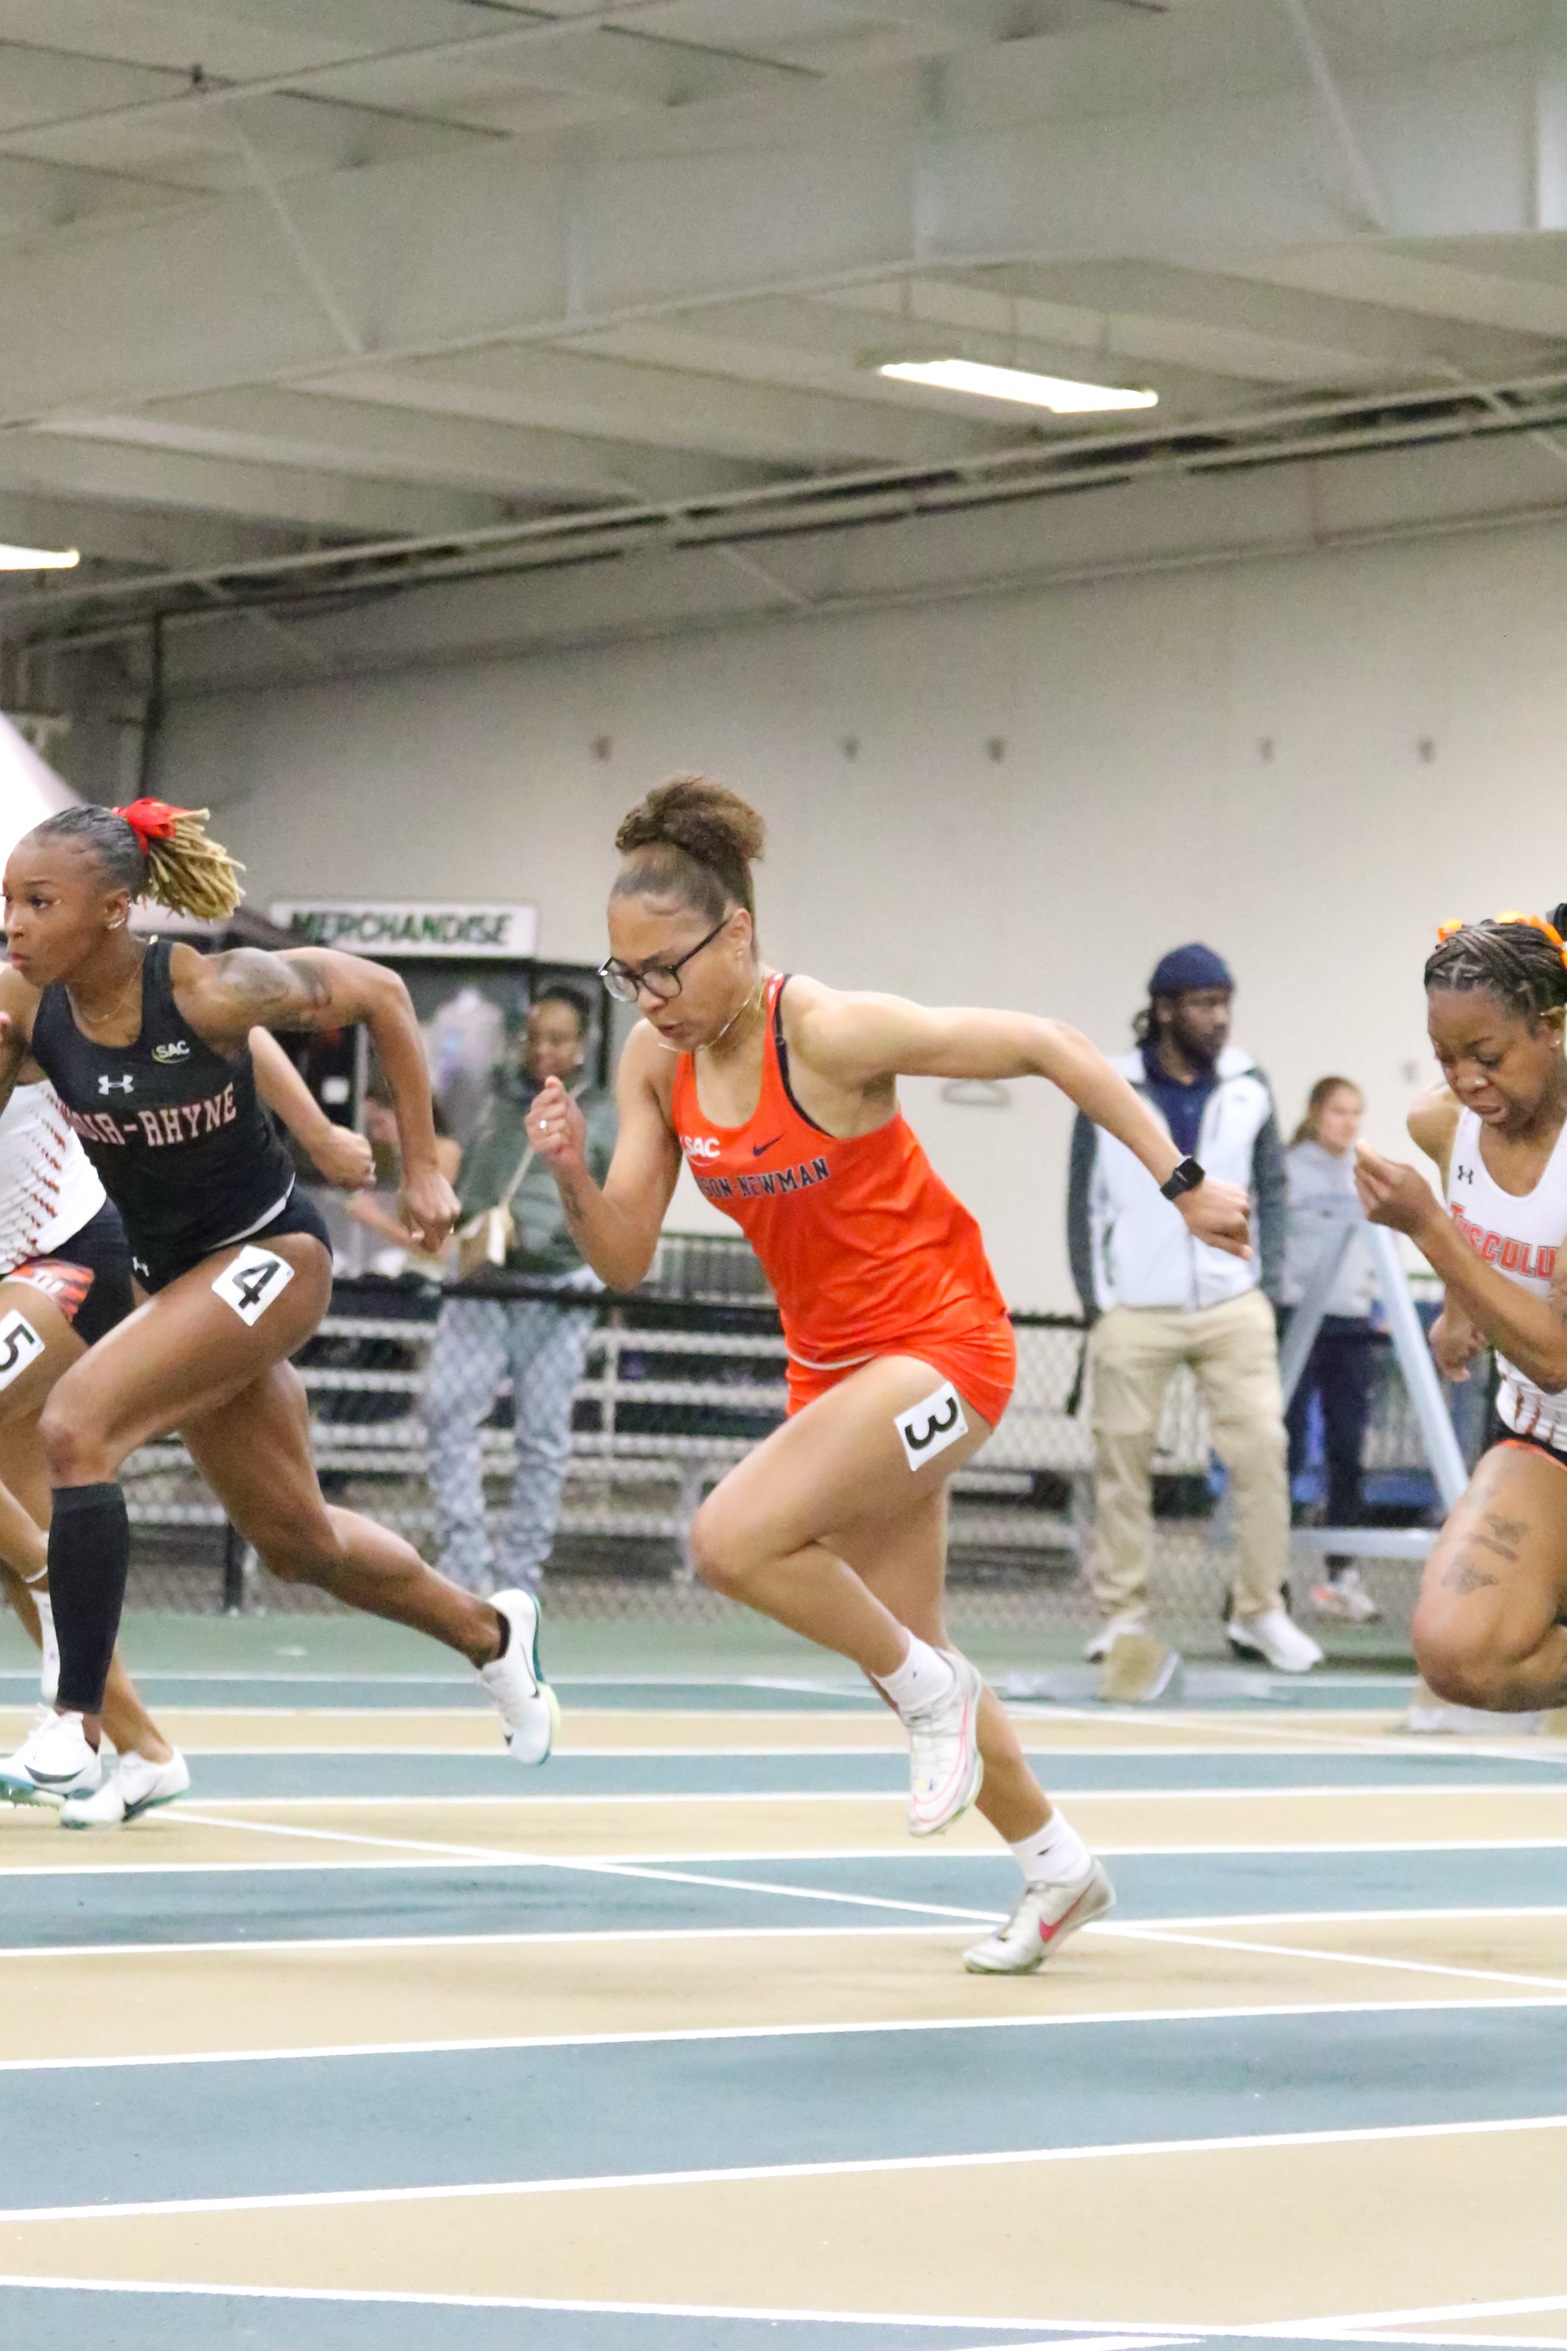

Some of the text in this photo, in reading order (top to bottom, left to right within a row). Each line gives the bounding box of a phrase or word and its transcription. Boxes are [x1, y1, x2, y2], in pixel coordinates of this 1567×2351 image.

[293, 911, 512, 945] MERCHANDISE
[155, 1039, 190, 1059] SAC
[684, 1136, 721, 1158] SAC
[696, 1156, 830, 1198] SON-NEWMAN
[232, 1259, 281, 1310] 4
[0, 1323, 36, 1371] 5
[904, 1396, 958, 1451] 3
